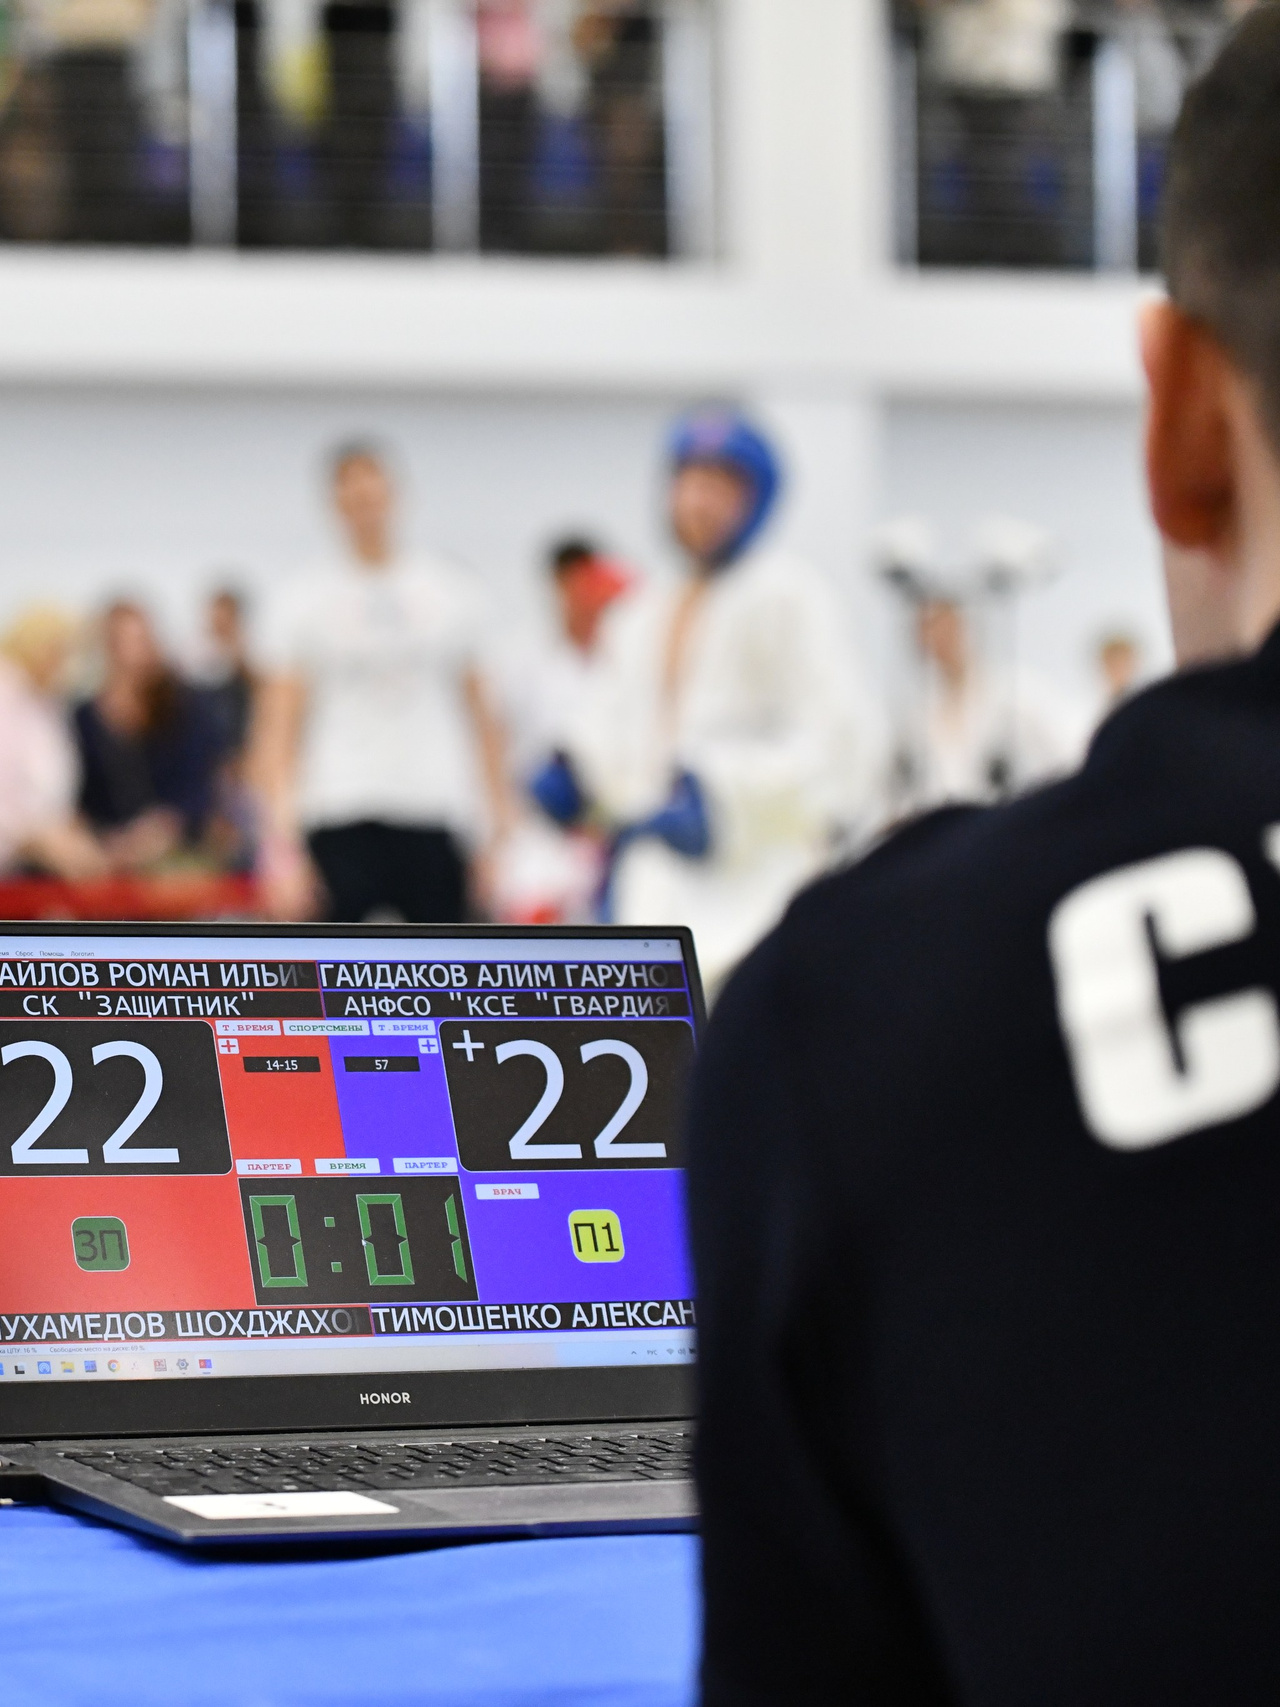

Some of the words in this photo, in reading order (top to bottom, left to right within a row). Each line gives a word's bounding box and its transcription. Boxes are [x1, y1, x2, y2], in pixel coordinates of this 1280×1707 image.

[109, 963, 210, 987] РОМАН
[320, 962, 468, 989] ГАЙДАКОВ
[478, 964, 556, 987] АЛИМ
[23, 995, 59, 1015] СК
[78, 991, 254, 1018] "ЗАЩИТНИК"
[344, 996, 431, 1016] АНФСО
[289, 1024, 363, 1032] СПОРТСМЕНЫ
[266, 1060, 298, 1070] 14-15
[374, 1059, 389, 1070] 57
[1, 1040, 179, 1164] 22
[329, 1162, 366, 1170] ВРЕМЯ
[404, 1161, 448, 1169] ПАРТЕР
[249, 1193, 468, 1287] 0:01
[574, 1222, 620, 1252] П1
[371, 1304, 562, 1332] ТИМОШЕНКО
[360, 1392, 411, 1405] HONOR
